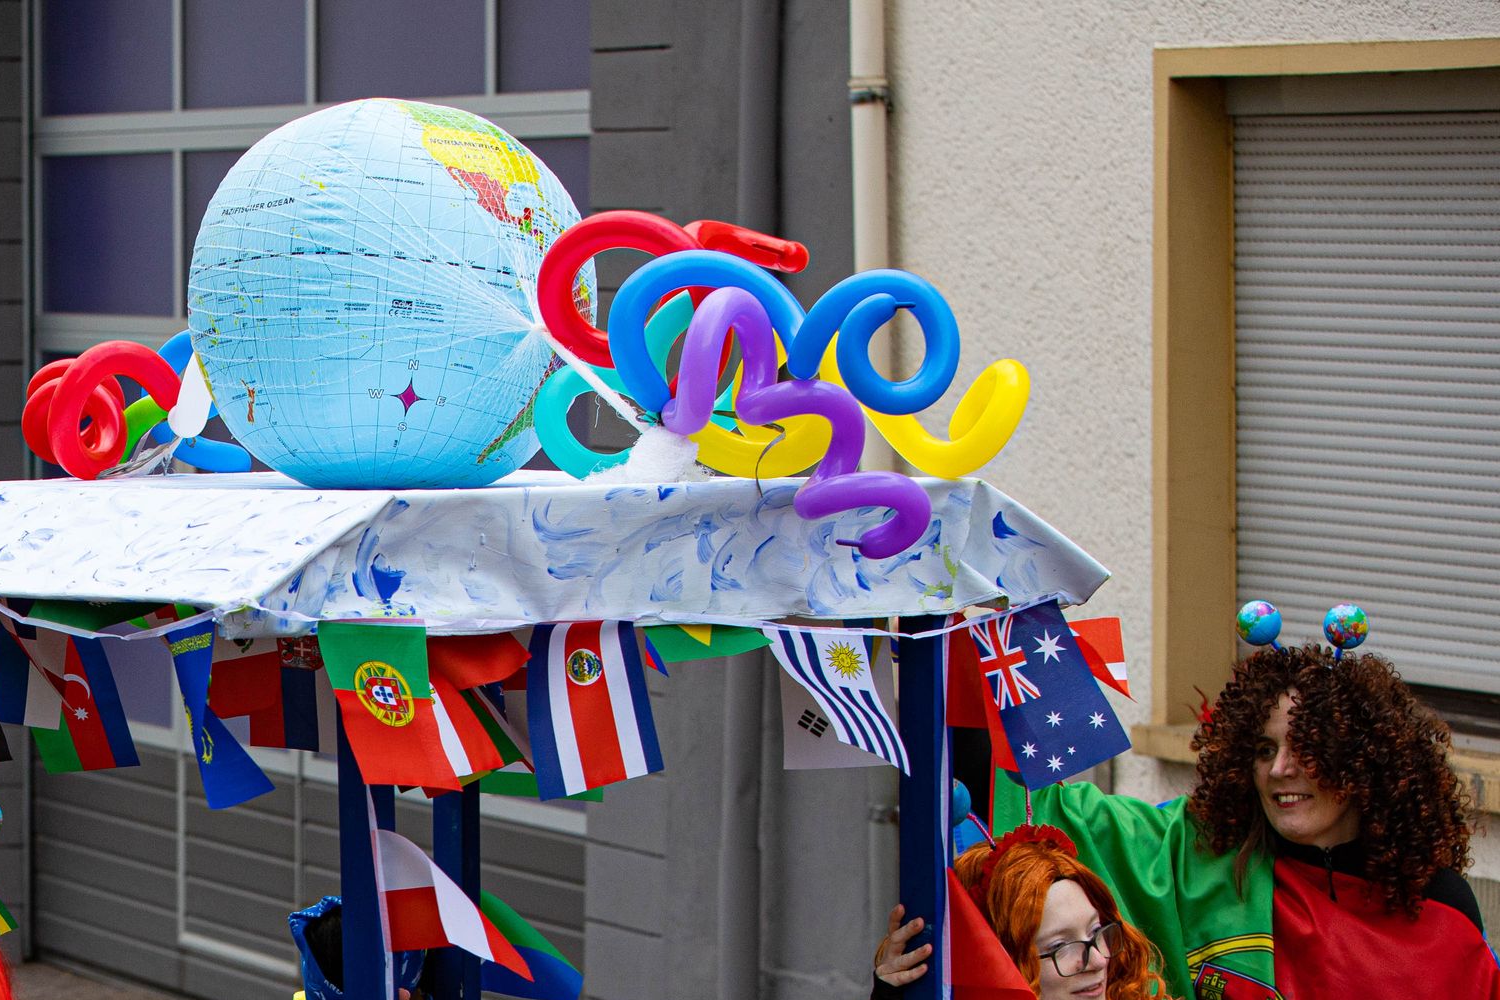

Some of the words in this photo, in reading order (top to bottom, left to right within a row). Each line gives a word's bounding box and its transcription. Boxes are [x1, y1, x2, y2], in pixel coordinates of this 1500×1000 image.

[266, 197, 296, 209] OZEAN
[408, 358, 420, 371] N
[368, 388, 385, 400] W
[435, 396, 447, 407] E
[397, 421, 408, 432] S
